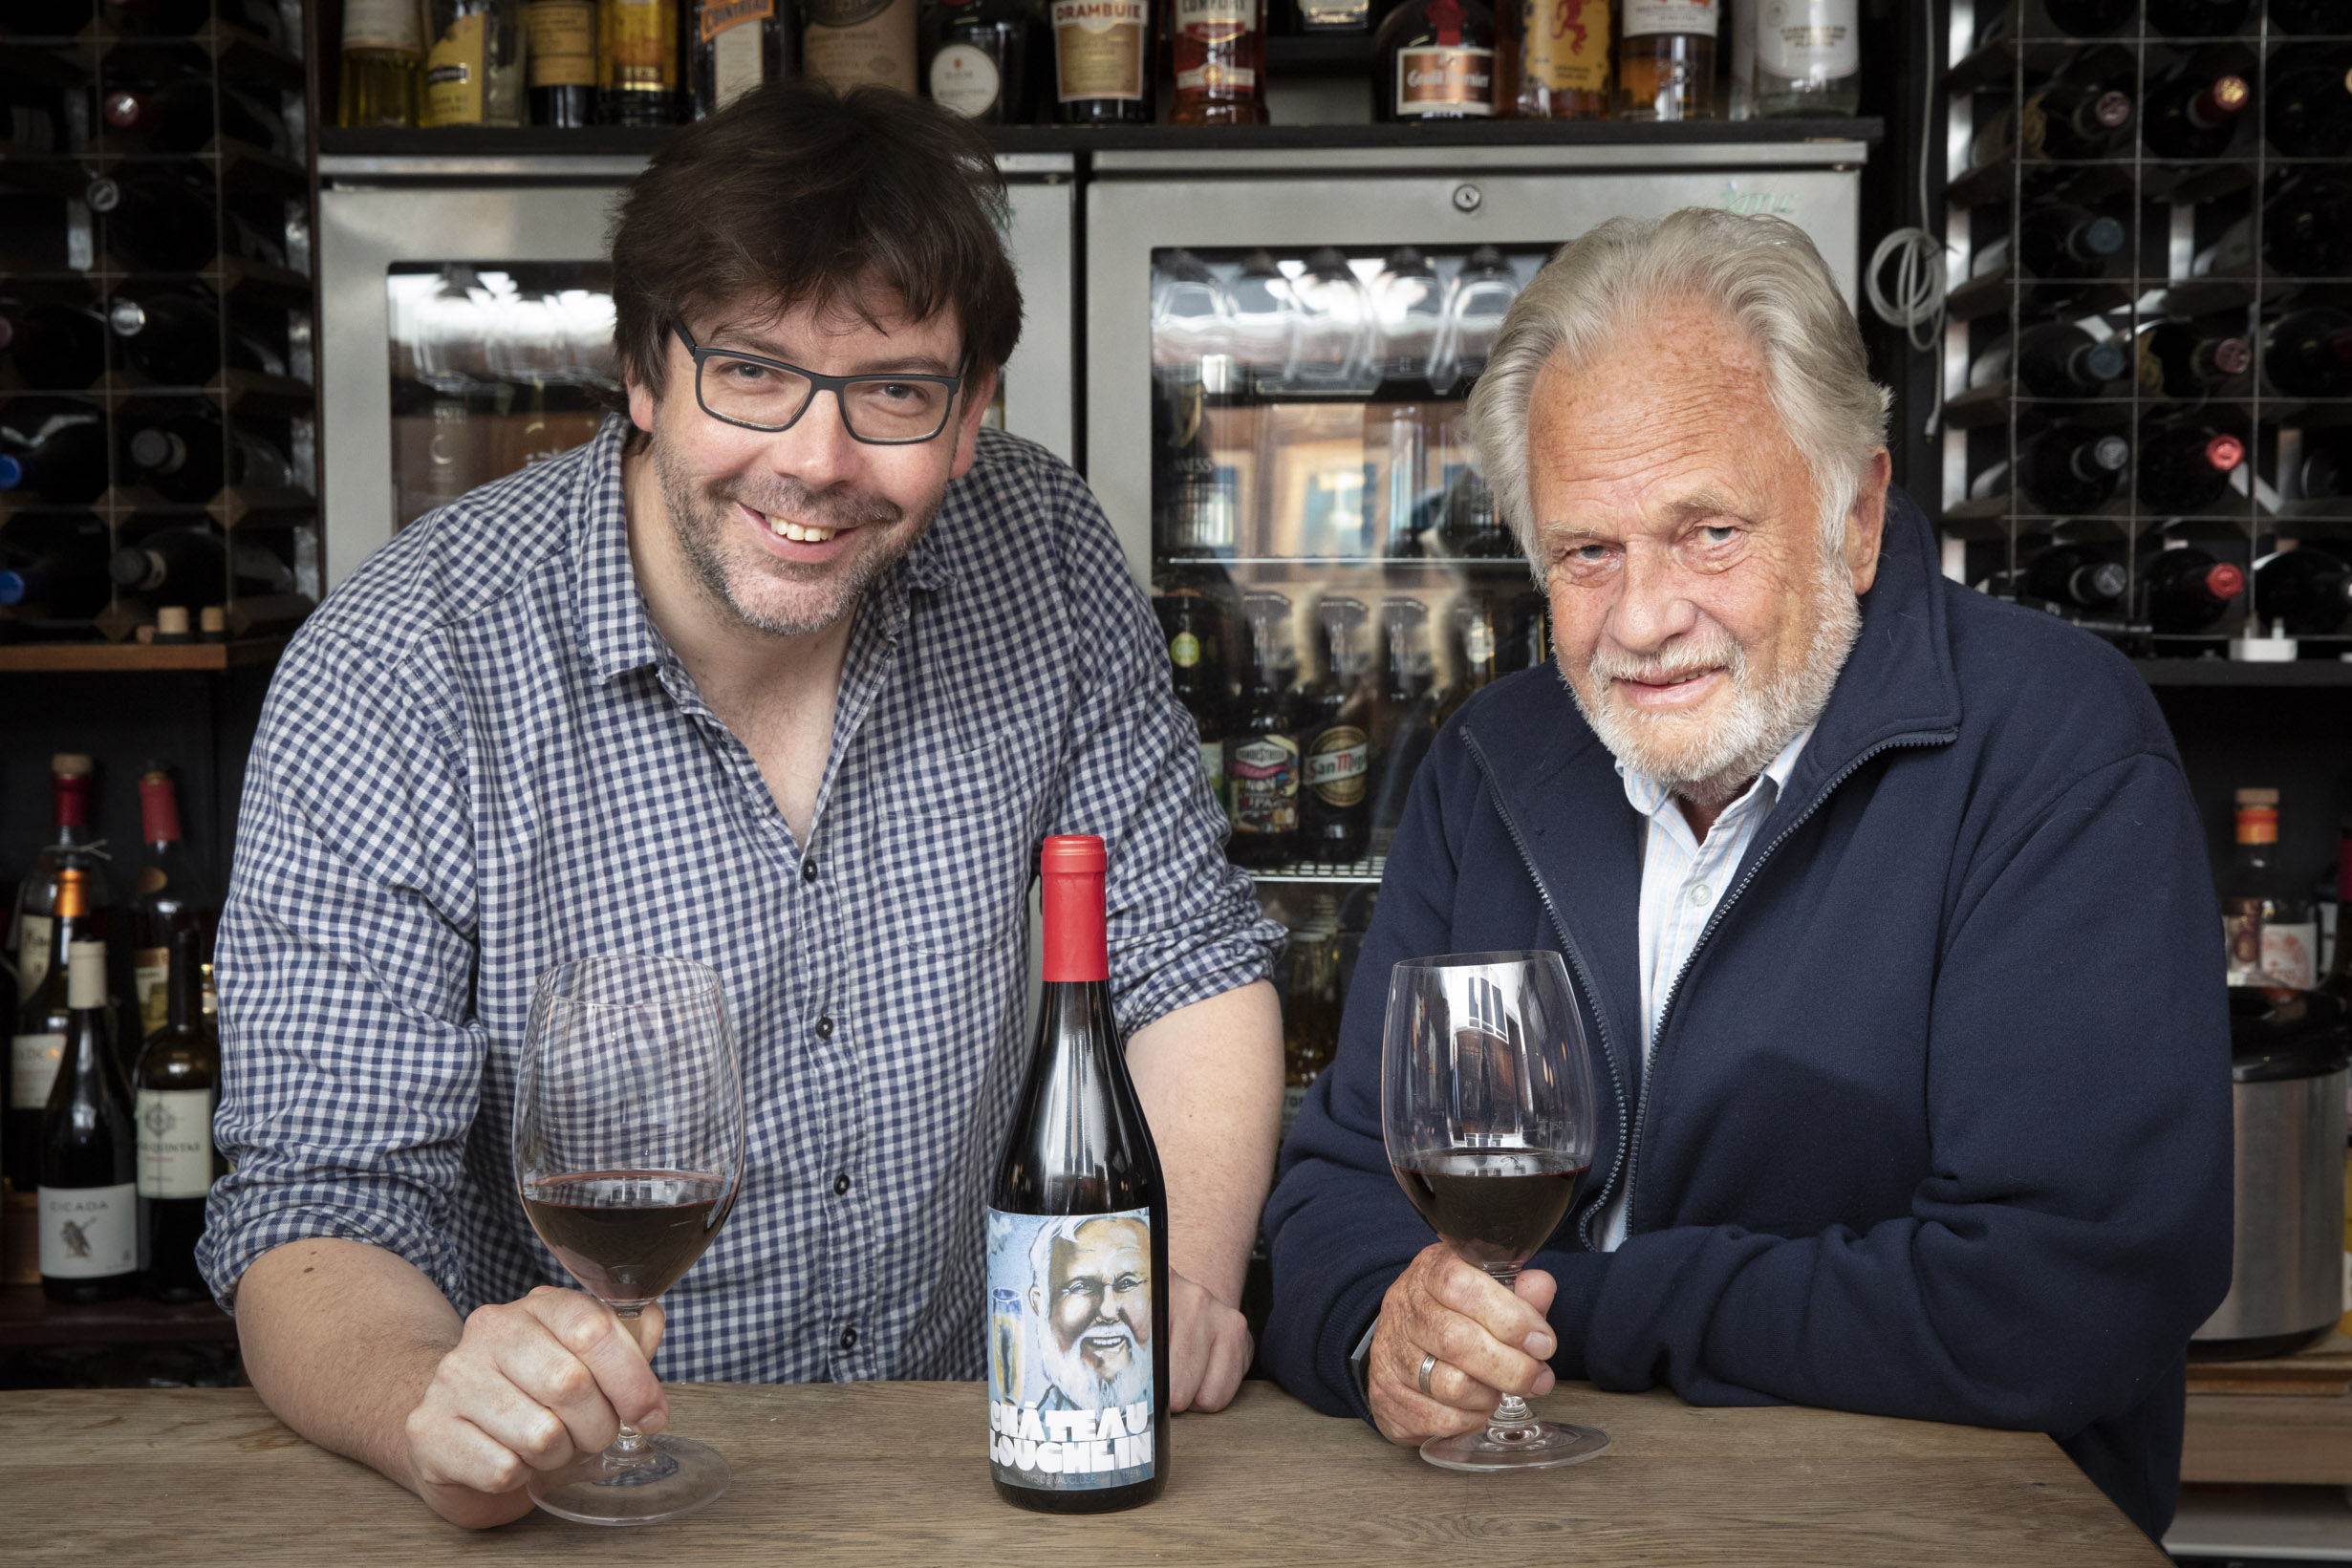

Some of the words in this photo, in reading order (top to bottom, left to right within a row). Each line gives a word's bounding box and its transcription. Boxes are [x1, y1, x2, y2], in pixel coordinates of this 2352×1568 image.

[1056, 3, 1141, 21] DRAMBUIE
[1307, 759, 1335, 781] San
[50, 1200, 109, 1213] CICADA
[990, 1400, 1149, 1442] CHÂTEAU
[989, 1428, 1152, 1473] LOUGHLIN
[1022, 1472, 1039, 1483] PAYS
[1040, 1474, 1050, 1484] DE
[1053, 1473, 1097, 1485] VAUCLUSE
